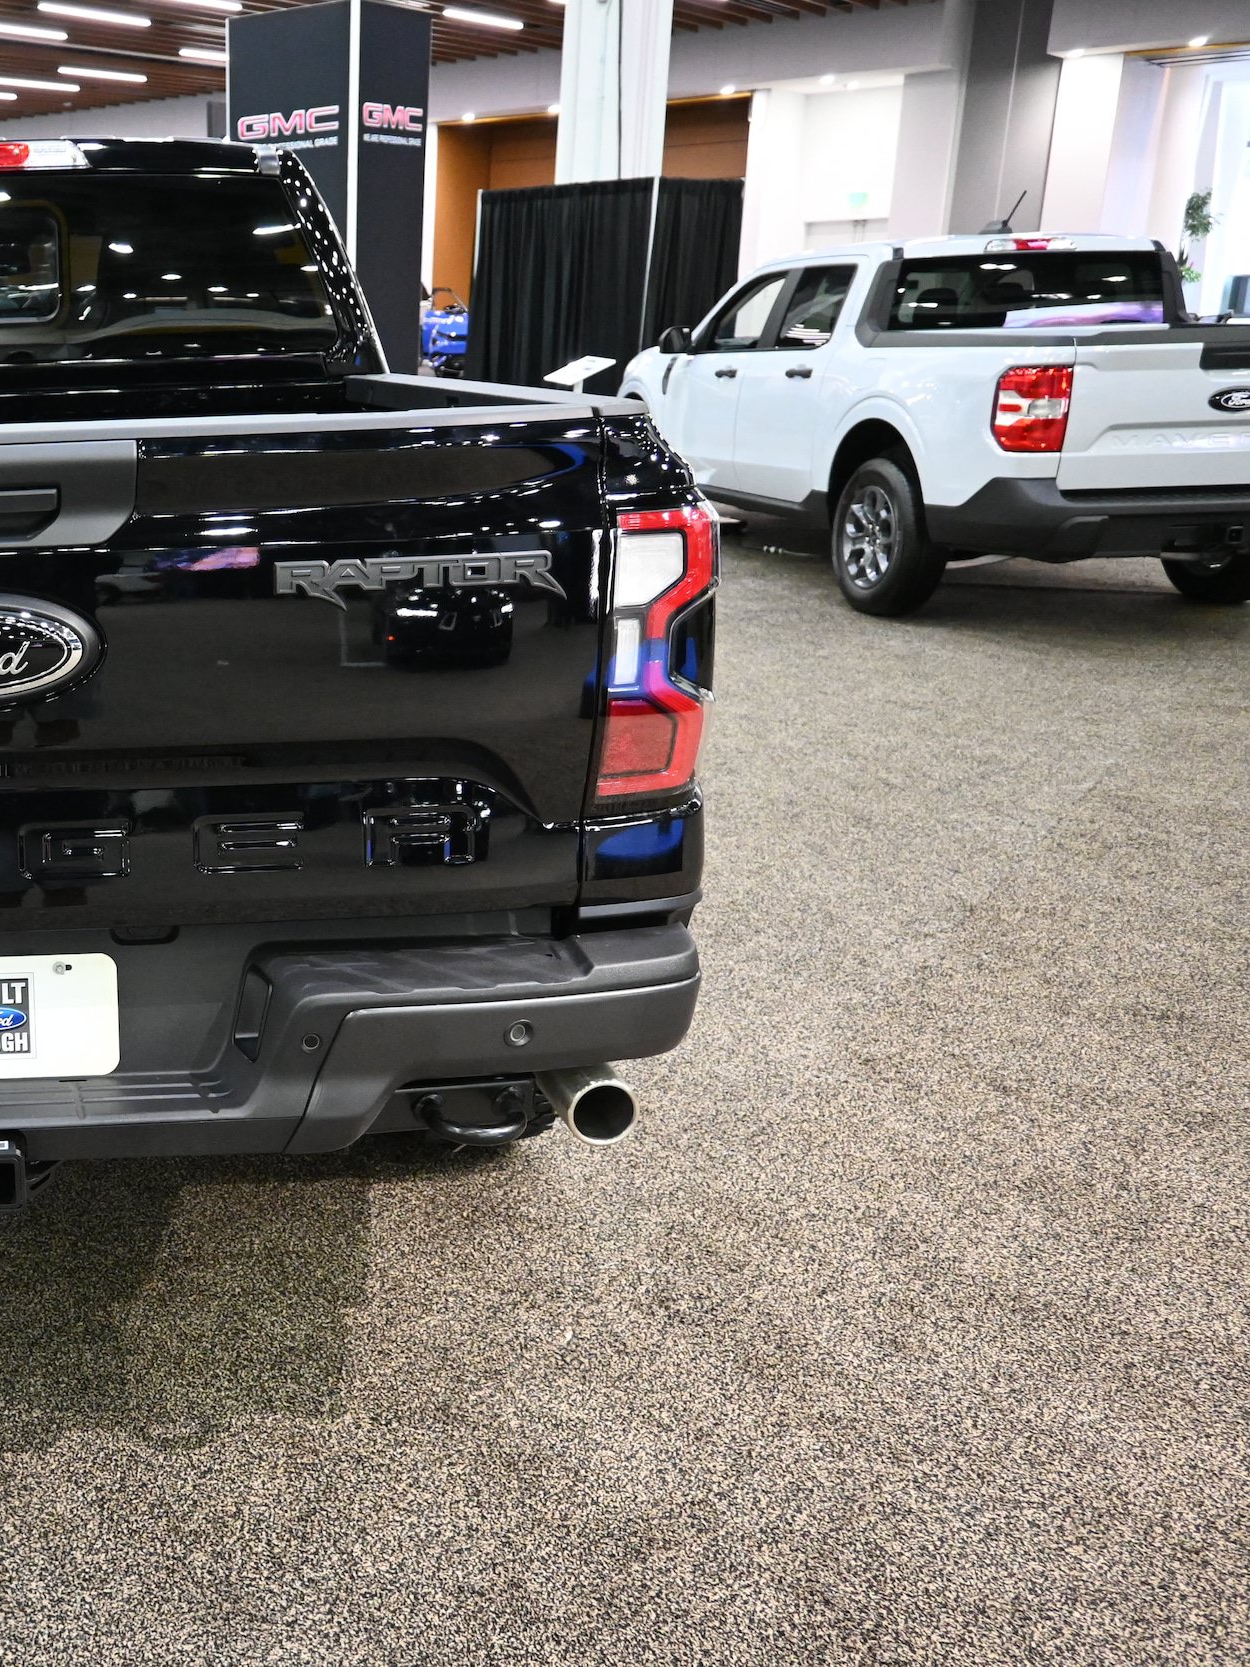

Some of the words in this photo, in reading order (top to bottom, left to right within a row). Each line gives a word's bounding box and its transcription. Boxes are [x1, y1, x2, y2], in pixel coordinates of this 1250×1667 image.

[237, 105, 339, 140] GMC
[363, 102, 423, 132] GMC
[273, 550, 567, 612] RAPTOR
